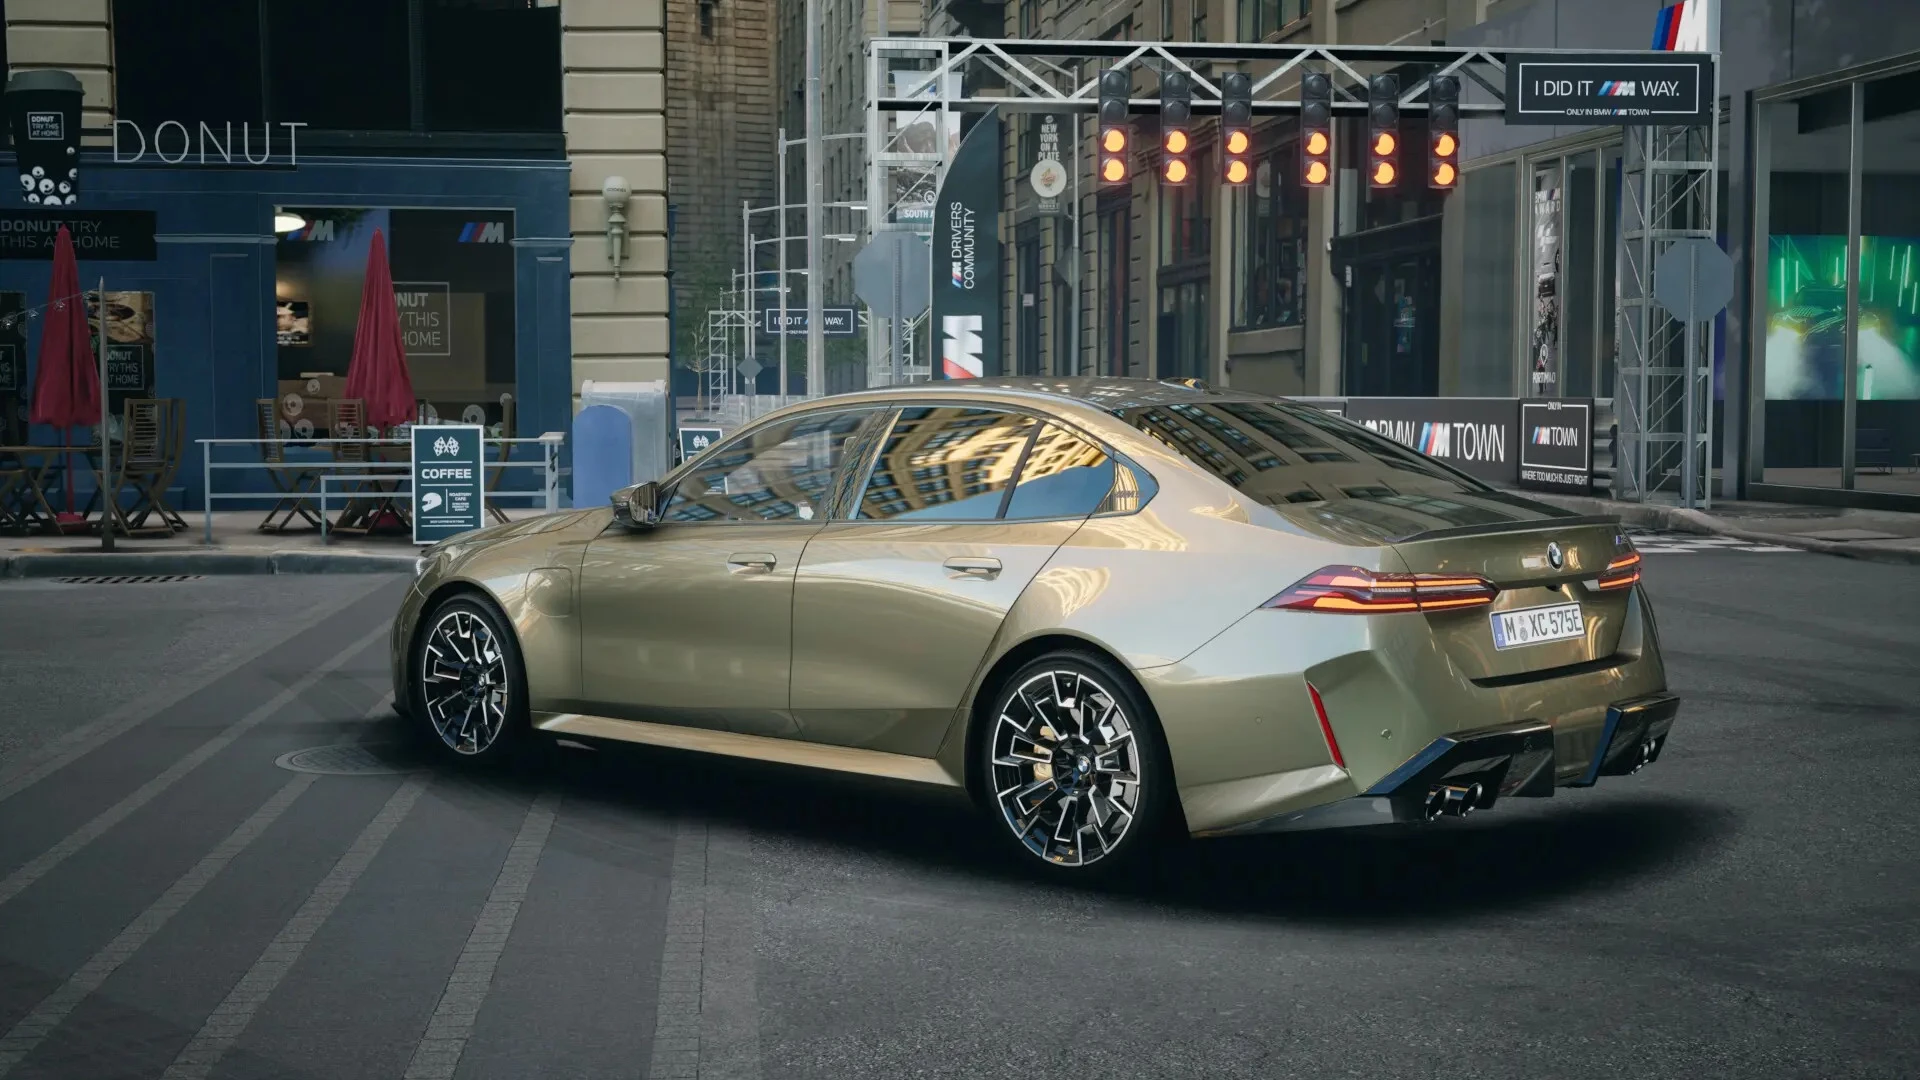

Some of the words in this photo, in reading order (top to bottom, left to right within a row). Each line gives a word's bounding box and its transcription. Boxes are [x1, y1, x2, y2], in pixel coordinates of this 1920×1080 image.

[1535, 81, 1538, 96] I
[1544, 81, 1572, 96] DID
[1578, 81, 1593, 96] IT
[1641, 81, 1680, 97] WAY.
[1566, 108, 1584, 116] ONLY
[1585, 108, 1592, 116] IN
[1593, 108, 1612, 116] BMW
[1628, 108, 1650, 116] TOWN
[1041, 124, 1057, 133] NEW
[114, 119, 308, 166] DONUT
[1040, 133, 1058, 143] YORK
[1040, 142, 1050, 152] ON
[1052, 142, 1057, 151] A
[1038, 151, 1060, 160] PLATE
[904, 209, 929, 219] SOUTH
[0, 219, 62, 232] DONUT
[67, 220, 102, 233] TRY
[951, 201, 962, 258] DRIVERS
[0, 235, 37, 248] THIS
[963, 207, 975, 290] COMMUNITY
[393, 292, 428, 307] NUT
[406, 311, 439, 326] THIS
[825, 316, 844, 325] WAY.
[121, 362, 138, 372] THIS
[116, 374, 140, 384] HOME
[1547, 402, 1556, 410] ONLY
[1453, 422, 1505, 462] TOWN
[1551, 427, 1578, 447] TOWN
[421, 468, 472, 479] COFFEE
[1521, 470, 1536, 480] WHERE
[1537, 471, 1545, 481] TOO
[1545, 472, 1558, 482] MUCH
[1563, 474, 1575, 484] JUST
[1575, 475, 1588, 486] RIGHT
[1504, 617, 1517, 641] M
[1529, 612, 1548, 637] XC
[1549, 608, 1582, 635] 575E
